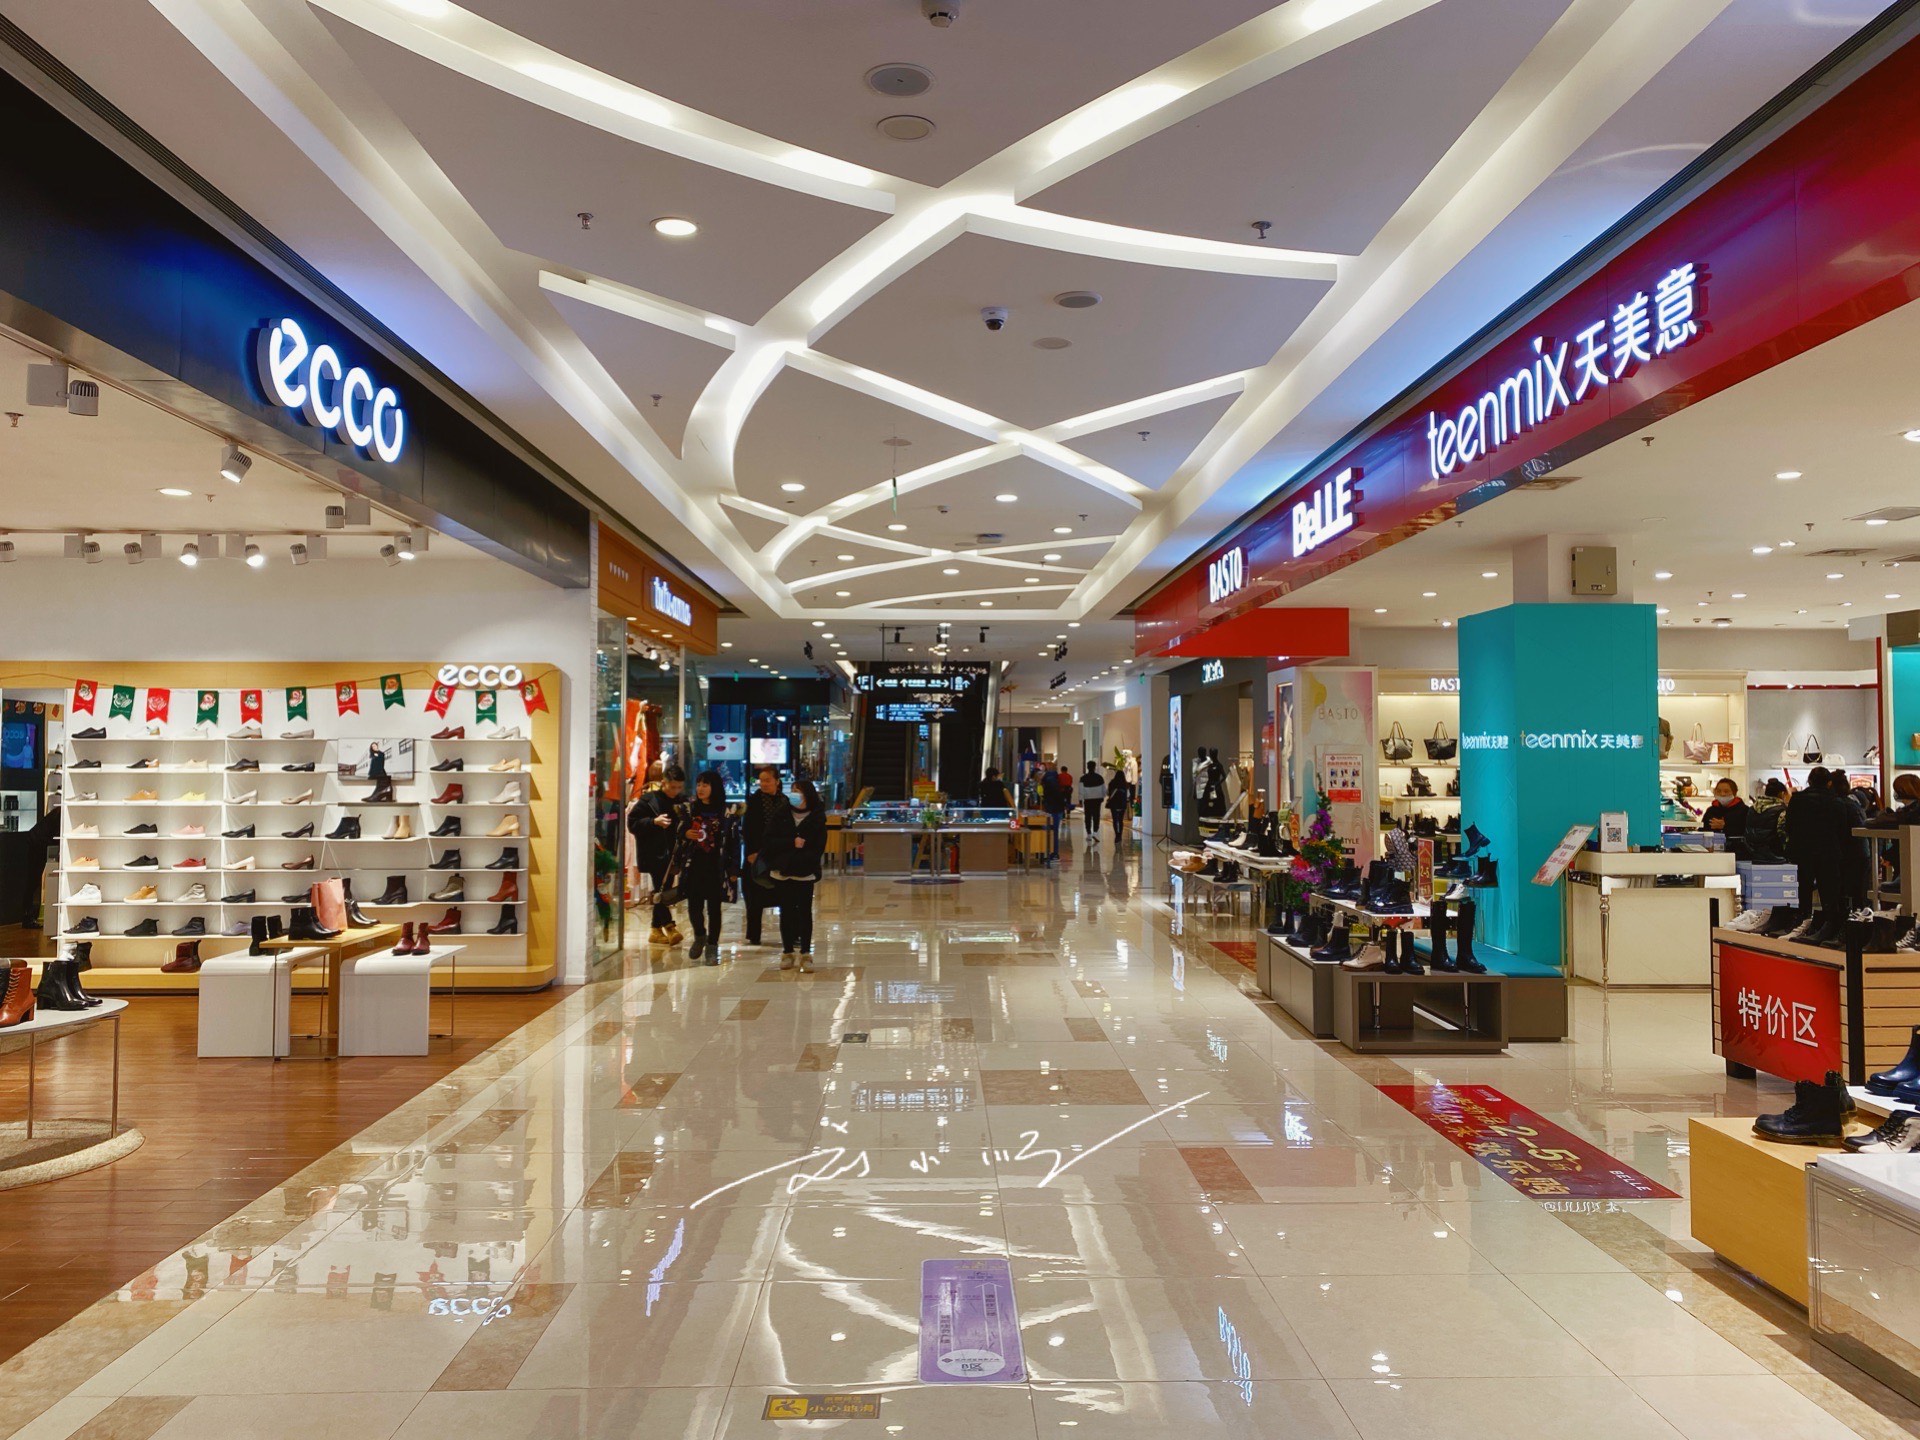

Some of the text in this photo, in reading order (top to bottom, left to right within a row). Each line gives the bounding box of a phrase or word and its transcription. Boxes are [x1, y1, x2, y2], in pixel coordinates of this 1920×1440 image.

[268, 317, 406, 464] ecco
[1427, 262, 1698, 480] teenmix 天美意
[1209, 547, 1243, 603] BASTO
[437, 664, 524, 688] ecco
[1430, 677, 1460, 691] BAST
[1520, 729, 1644, 749] teenmix 天美意
[1737, 986, 1819, 1048] 特价区
[1609, 1170, 1652, 1192] BELLE
